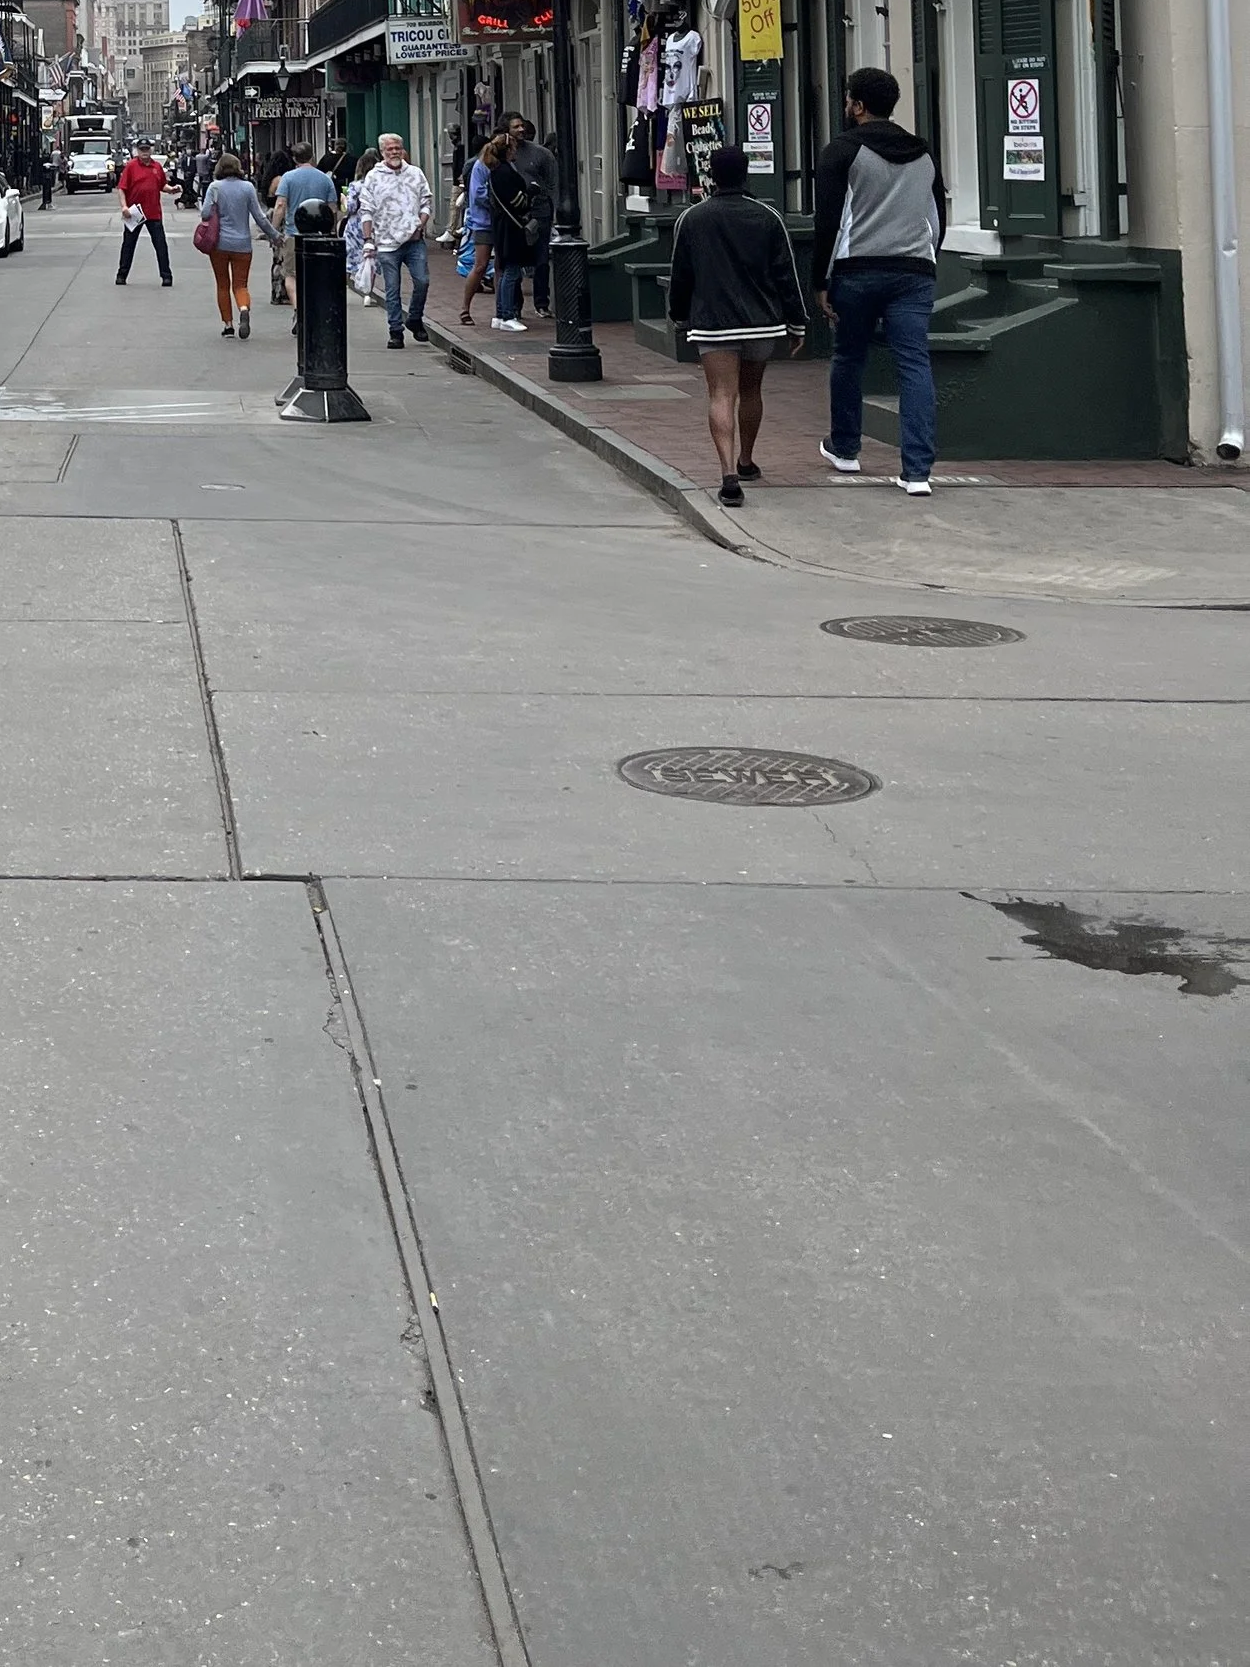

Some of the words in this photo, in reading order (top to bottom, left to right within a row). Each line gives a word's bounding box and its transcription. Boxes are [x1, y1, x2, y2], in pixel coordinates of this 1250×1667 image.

[478, 14, 510, 30] GRILL
[534, 9, 554, 25] CLU
[750, 8, 775, 33] Off
[390, 30, 434, 43] TRICOU
[396, 51, 432, 59] LOWEST
[435, 48, 468, 57] PRICES
[401, 42, 461, 52] GUARANTEED
[683, 107, 697, 119] WE
[699, 104, 721, 118] SELL
